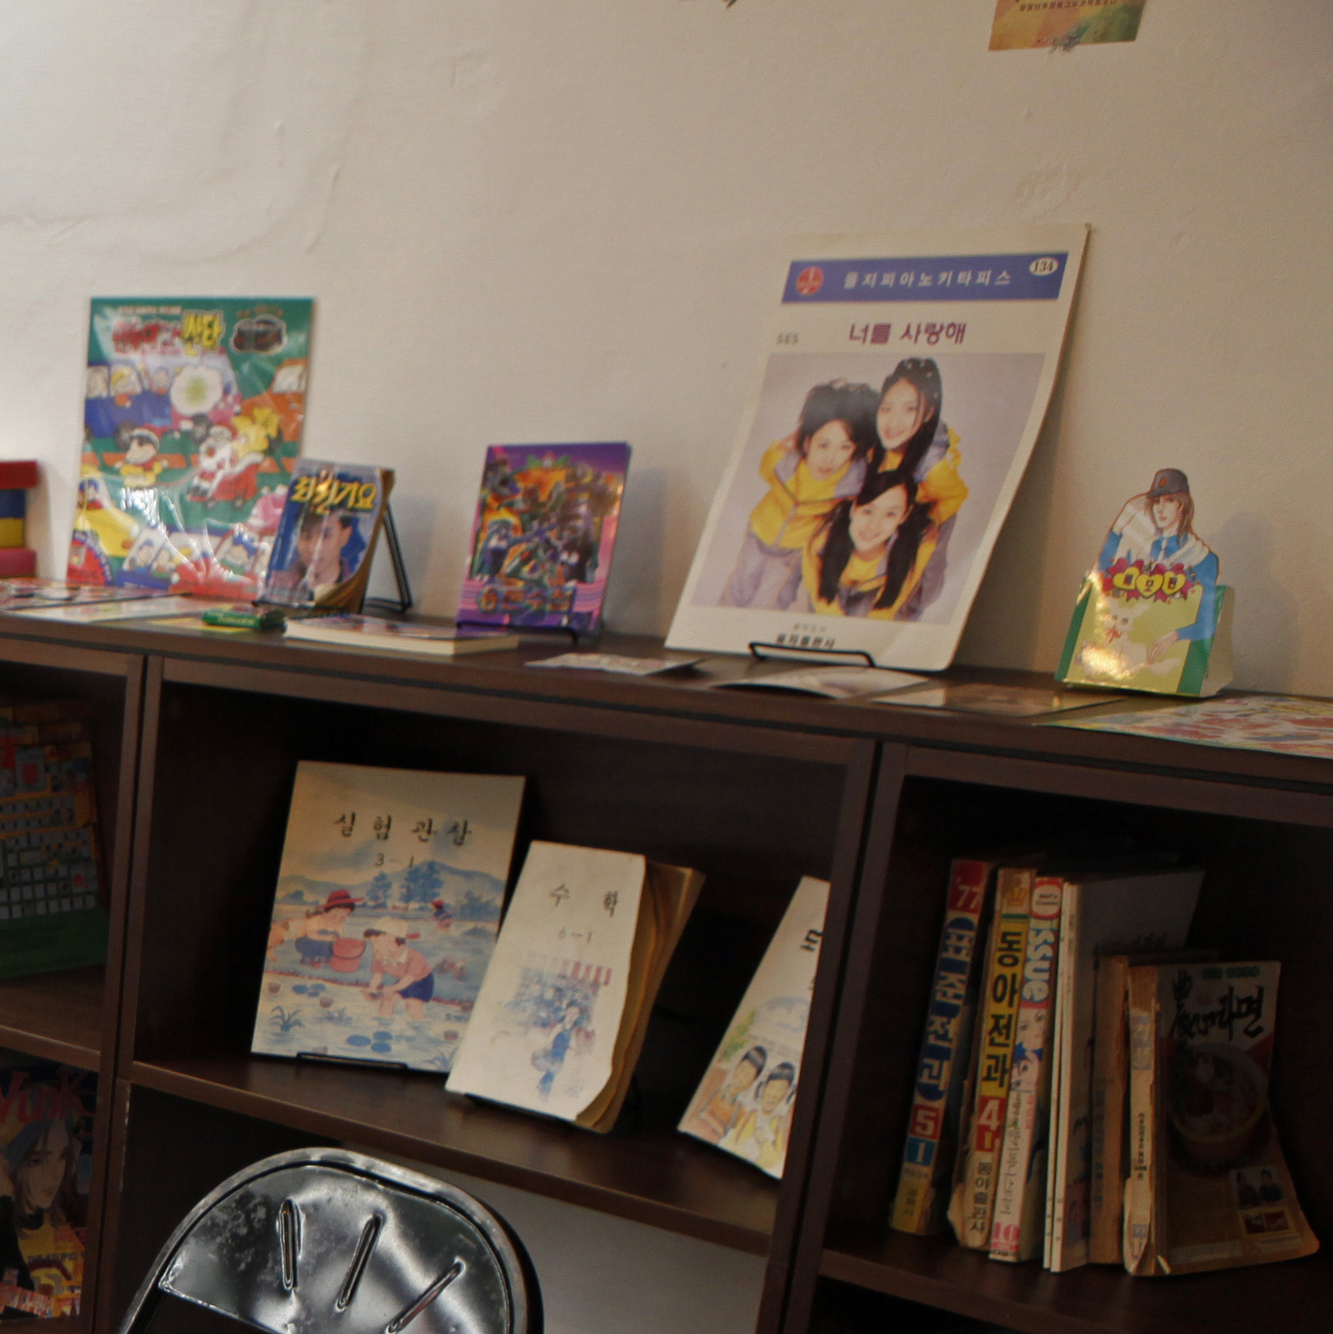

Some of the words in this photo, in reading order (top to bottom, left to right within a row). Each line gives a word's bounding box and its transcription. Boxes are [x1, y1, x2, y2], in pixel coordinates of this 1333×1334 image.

[1032, 258, 1056, 274] 134
[848, 323, 891, 345] 너를
[900, 322, 967, 346] 사랑해
[918, 922, 977, 1095] 표준전과
[981, 930, 1023, 1088] 동아전과
[914, 1109, 938, 1134] 5
[979, 1100, 1001, 1130] 4
[915, 1141, 926, 1163] 1
